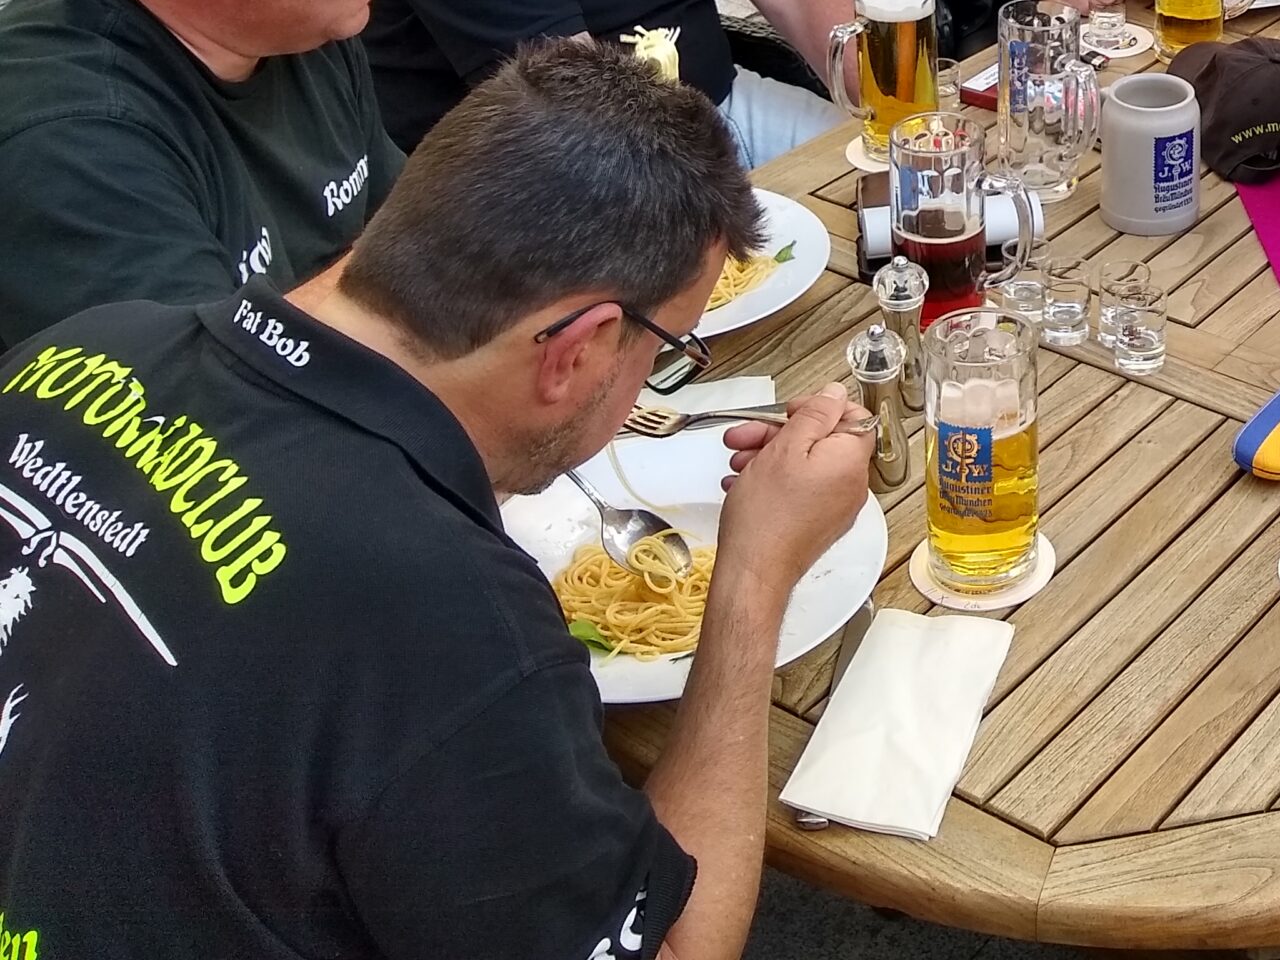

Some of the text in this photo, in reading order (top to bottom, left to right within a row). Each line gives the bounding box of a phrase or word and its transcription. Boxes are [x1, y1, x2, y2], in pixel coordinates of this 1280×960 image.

[1153, 177, 1193, 194] Augustiner
[233, 298, 311, 368] Fat Bob
